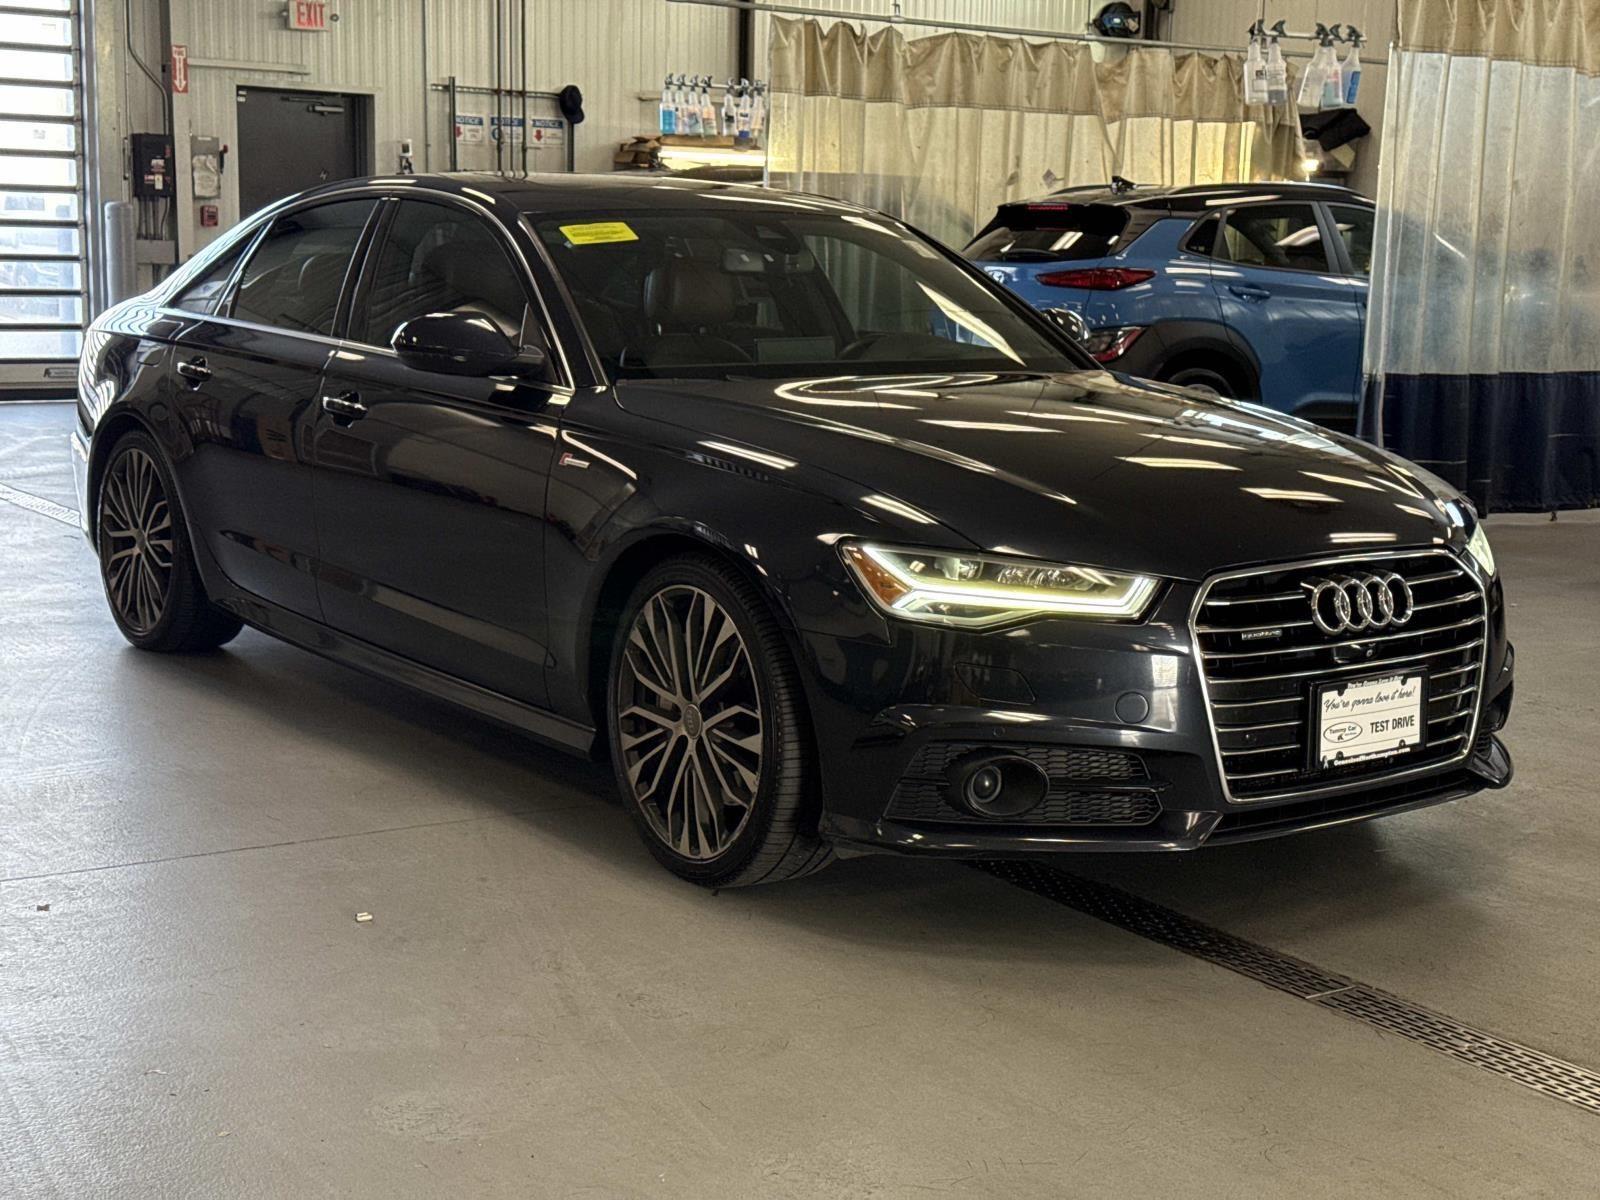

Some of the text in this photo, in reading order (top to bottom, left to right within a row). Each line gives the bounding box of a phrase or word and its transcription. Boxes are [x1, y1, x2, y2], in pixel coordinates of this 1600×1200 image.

[296, 1, 325, 27] EXIT
[1324, 686, 1416, 712] You're gonna love it here!
[1370, 715, 1415, 733] TEST DRIVE
